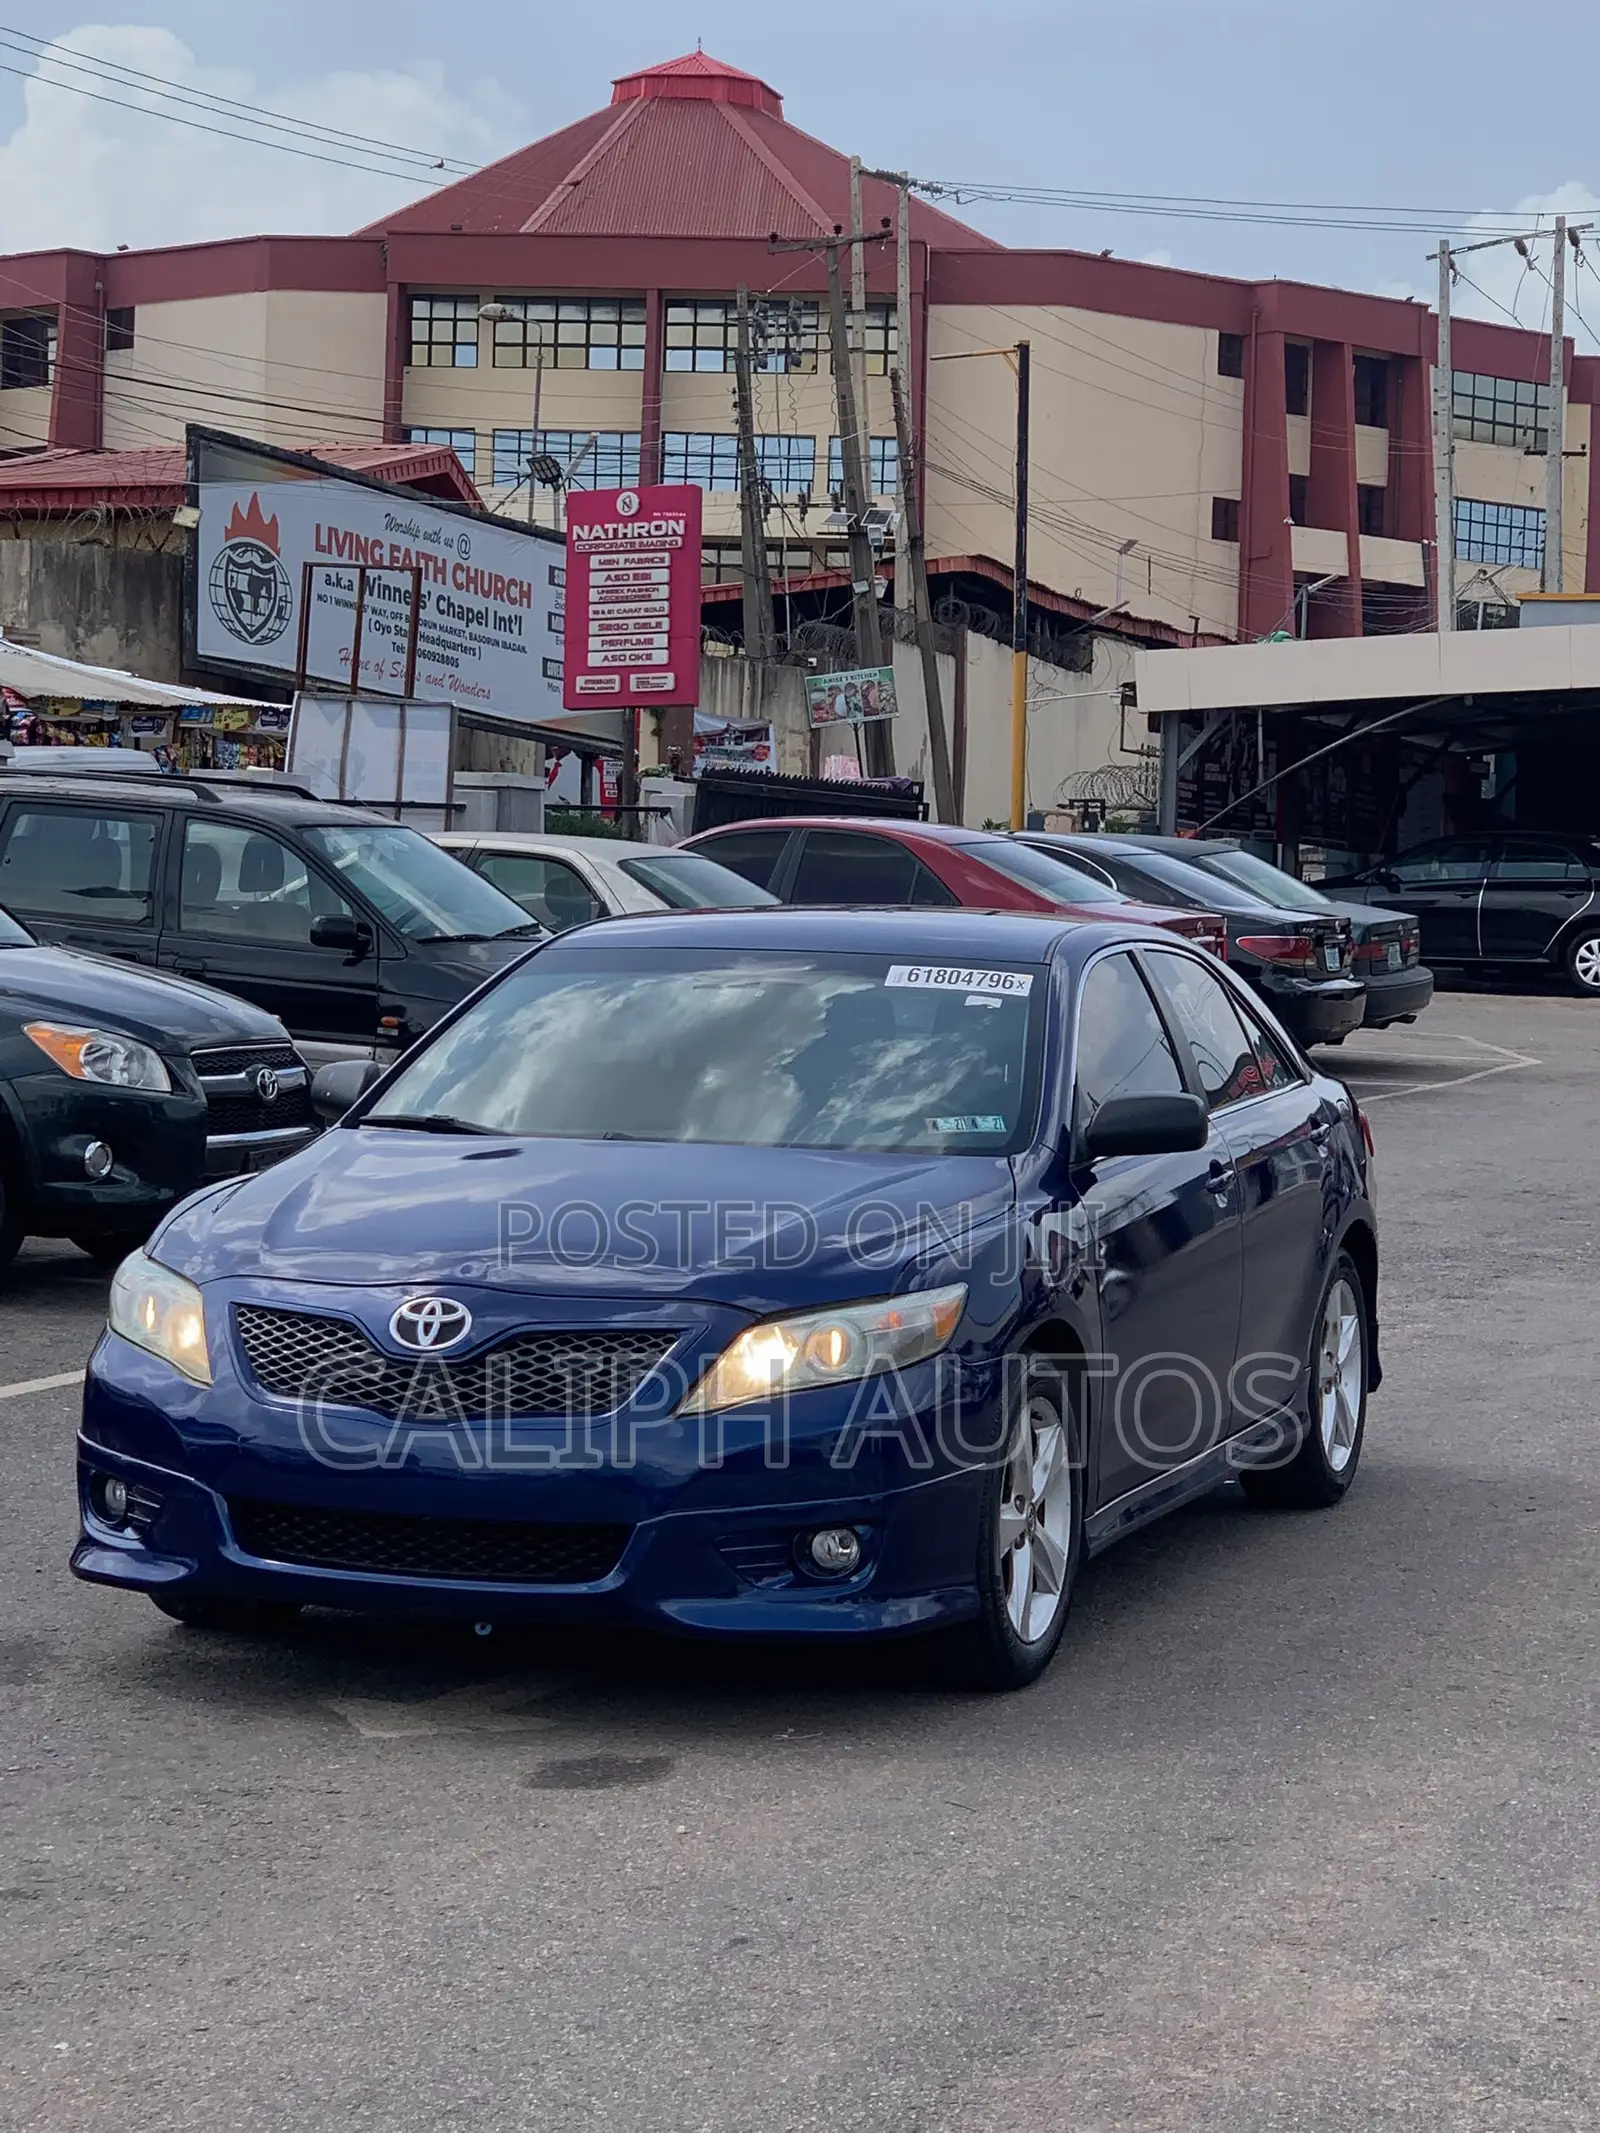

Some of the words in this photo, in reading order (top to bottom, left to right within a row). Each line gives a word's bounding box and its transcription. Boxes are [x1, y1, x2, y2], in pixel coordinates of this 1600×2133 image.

[384, 513, 421, 542] Worship
[423, 527, 442, 547] with
[444, 536, 454, 549] us
[457, 533, 471, 560] @
[572, 519, 685, 541] NATHRON
[576, 541, 636, 551] CORPORATE
[637, 539, 678, 549] IMAGING
[315, 522, 384, 567] LIVING
[452, 562, 532, 609] CHURCH
[598, 558, 619, 566] MEN
[624, 556, 666, 565] FABRICS
[604, 573, 630, 582] ASO
[632, 572, 652, 581] EBI
[324, 572, 354, 592] a.k.a
[363, 574, 431, 611] Winnes'
[436, 594, 489, 628] Chapel
[493, 609, 522, 636] Int'l
[317, 593, 328, 604] NO
[371, 606, 389, 620] WAY,
[390, 611, 404, 622] OFF
[439, 623, 468, 641] MARKET,
[469, 631, 501, 648] BASORUN
[598, 622, 629, 631] SEGO
[634, 621, 663, 630] GELE
[374, 620, 392, 636] Oyo
[394, 624, 408, 638] Sta
[419, 630, 477, 658] Headquarters
[601, 638, 654, 647] PERFUME
[391, 642, 406, 655] Tel:
[602, 654, 627, 662] ASO
[629, 653, 653, 661] OKE
[374, 657, 386, 680] of
[425, 672, 445, 688] and
[448, 674, 491, 699] Wonders
